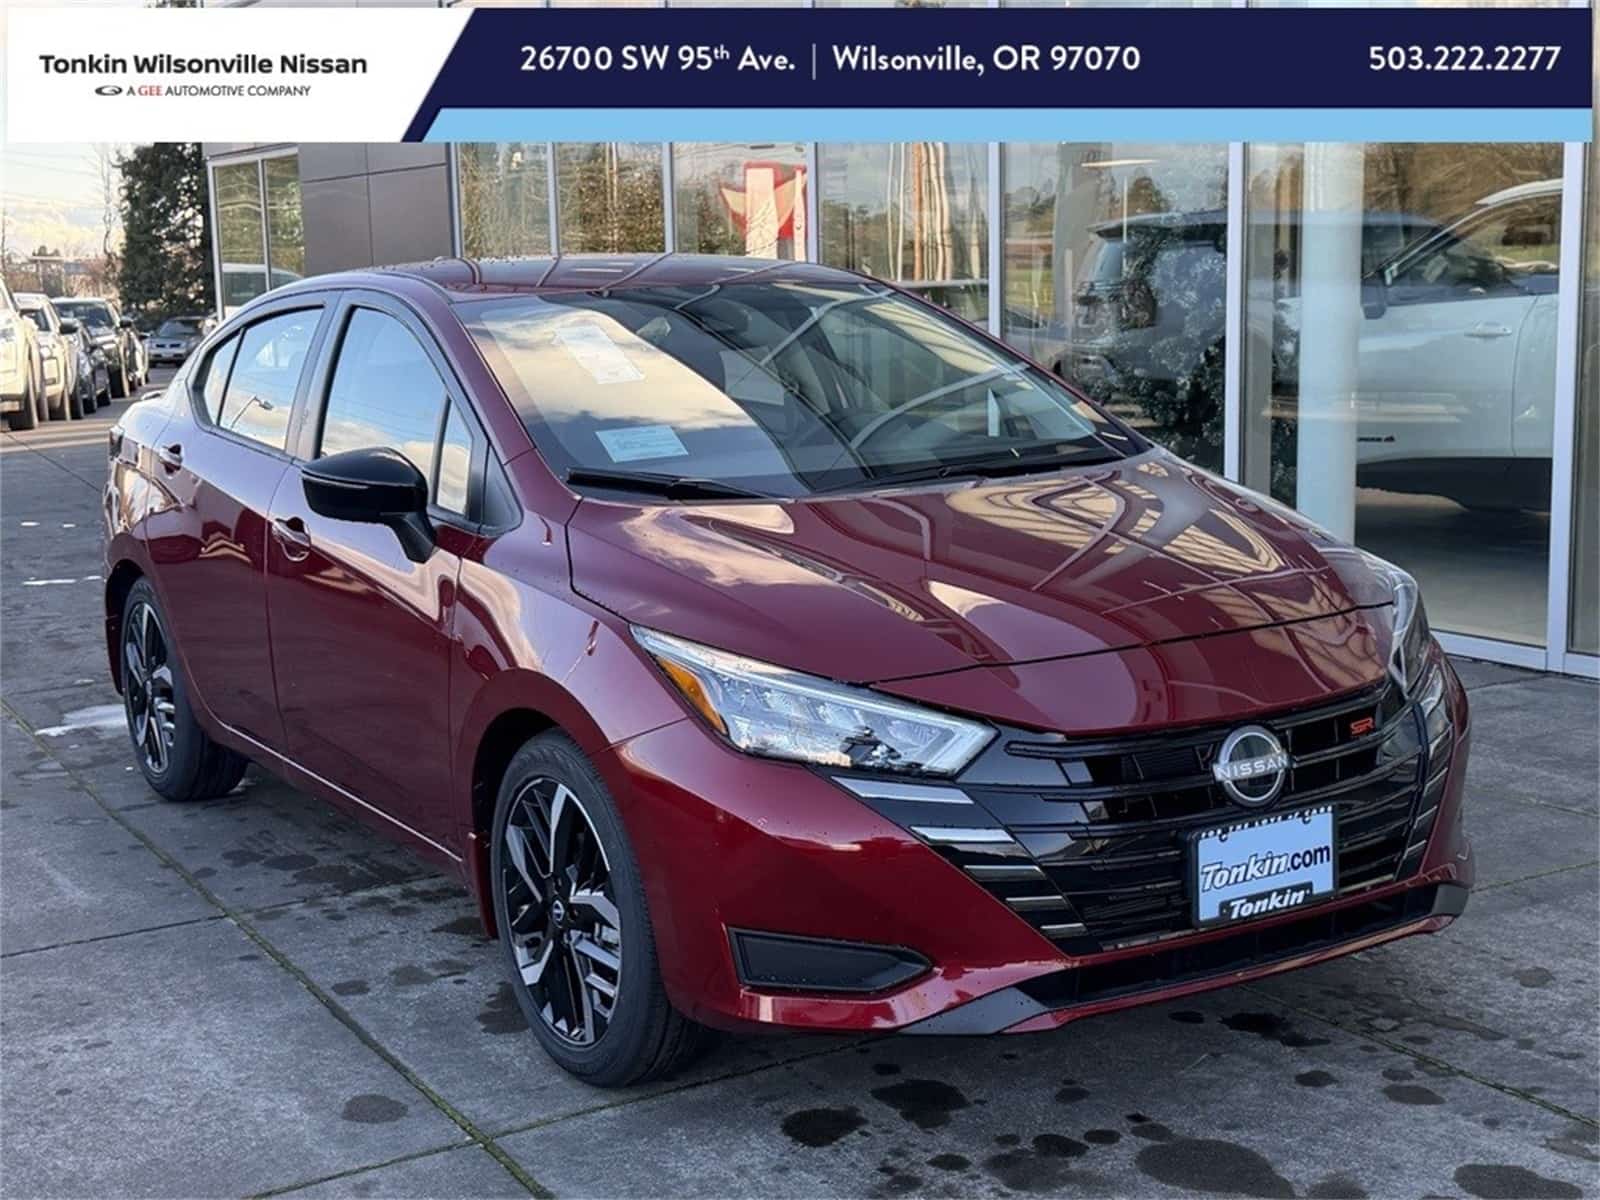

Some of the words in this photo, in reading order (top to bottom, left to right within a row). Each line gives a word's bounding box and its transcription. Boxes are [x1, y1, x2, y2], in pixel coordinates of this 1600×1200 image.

[1350, 717, 1374, 735] SR
[1215, 753, 1289, 779] NISSAN
[1201, 845, 1331, 893] Tonkin.com
[1229, 889, 1305, 919] Tonkin
